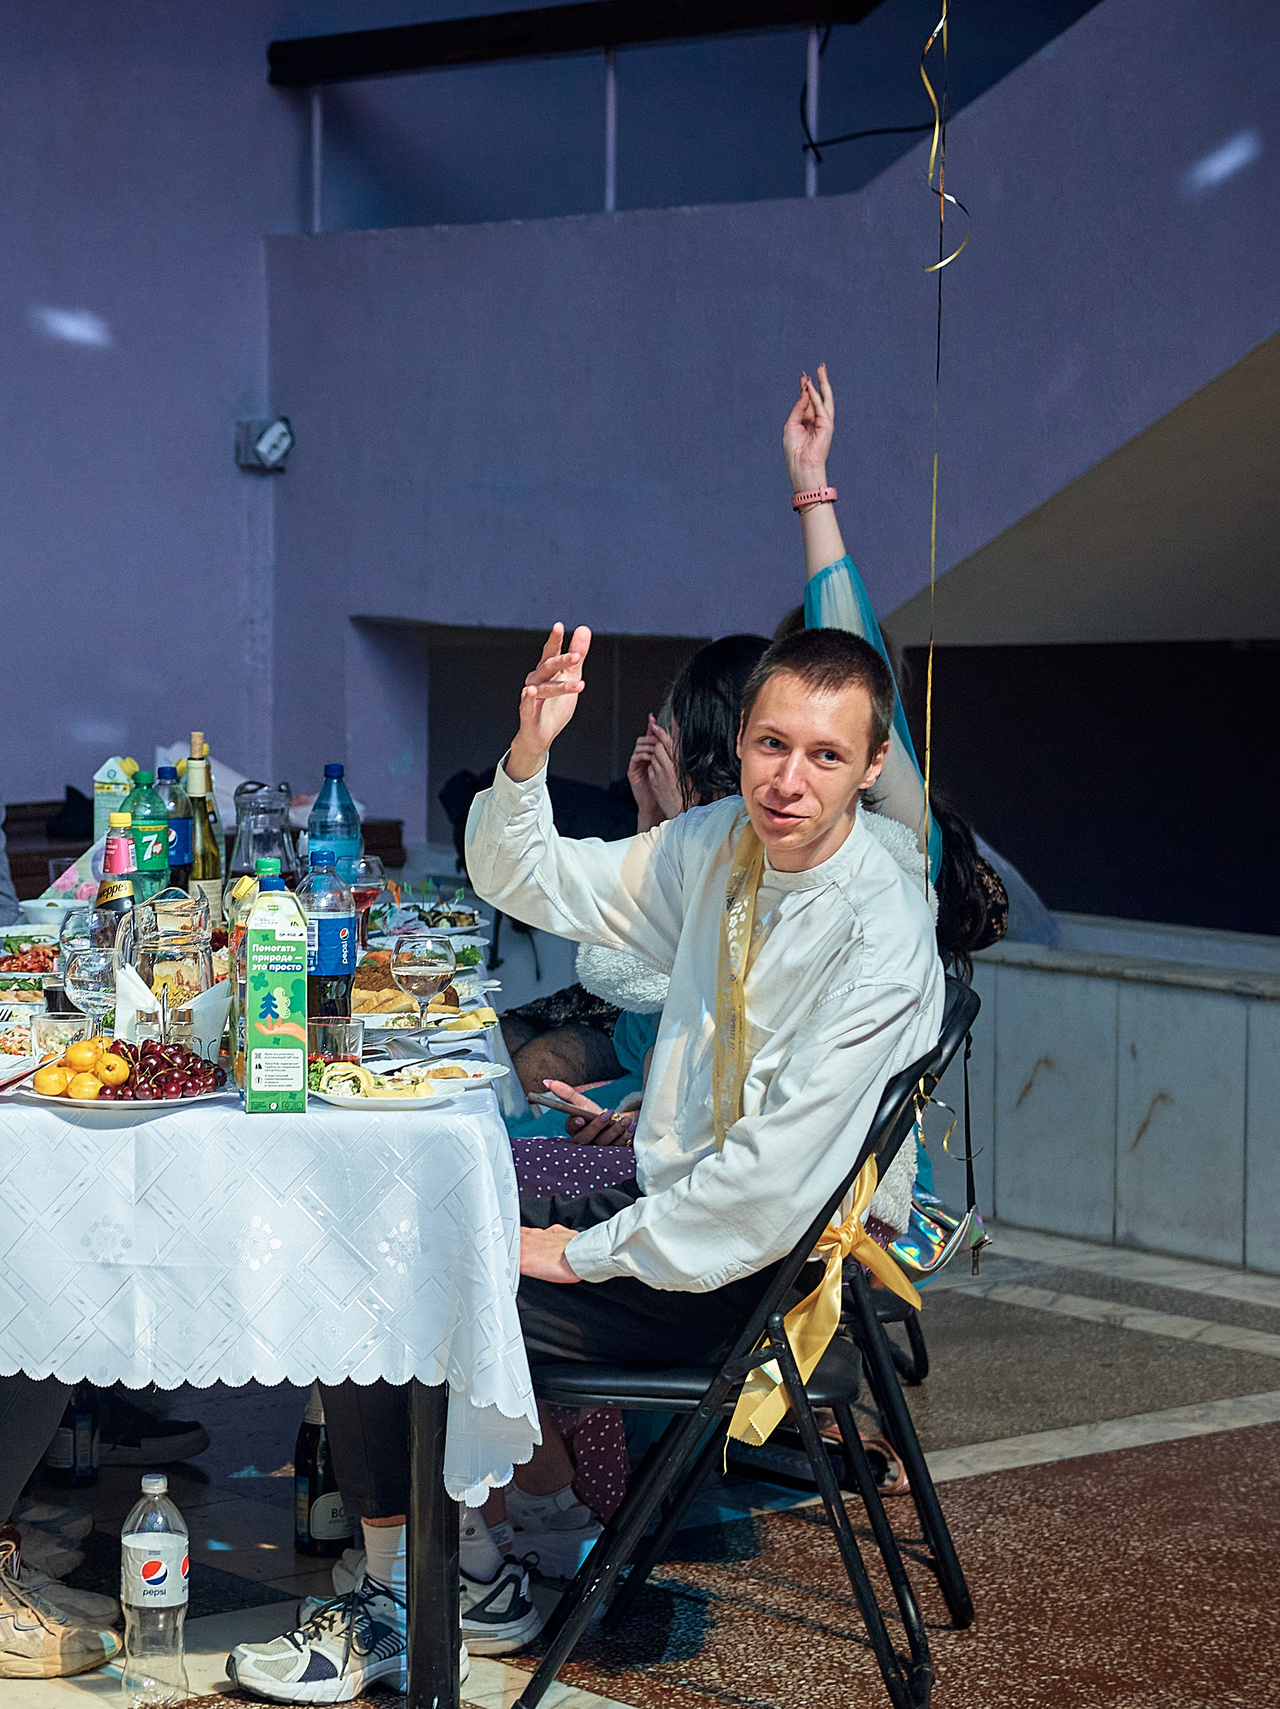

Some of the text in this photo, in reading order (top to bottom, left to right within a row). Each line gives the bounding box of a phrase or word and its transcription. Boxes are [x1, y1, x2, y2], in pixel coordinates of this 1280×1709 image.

[252, 943, 296, 952] Помогать
[341, 940, 349, 965] pepsi
[252, 954, 293, 962] природе
[268, 964, 302, 972] просто
[143, 1589, 167, 1597] pepsi
